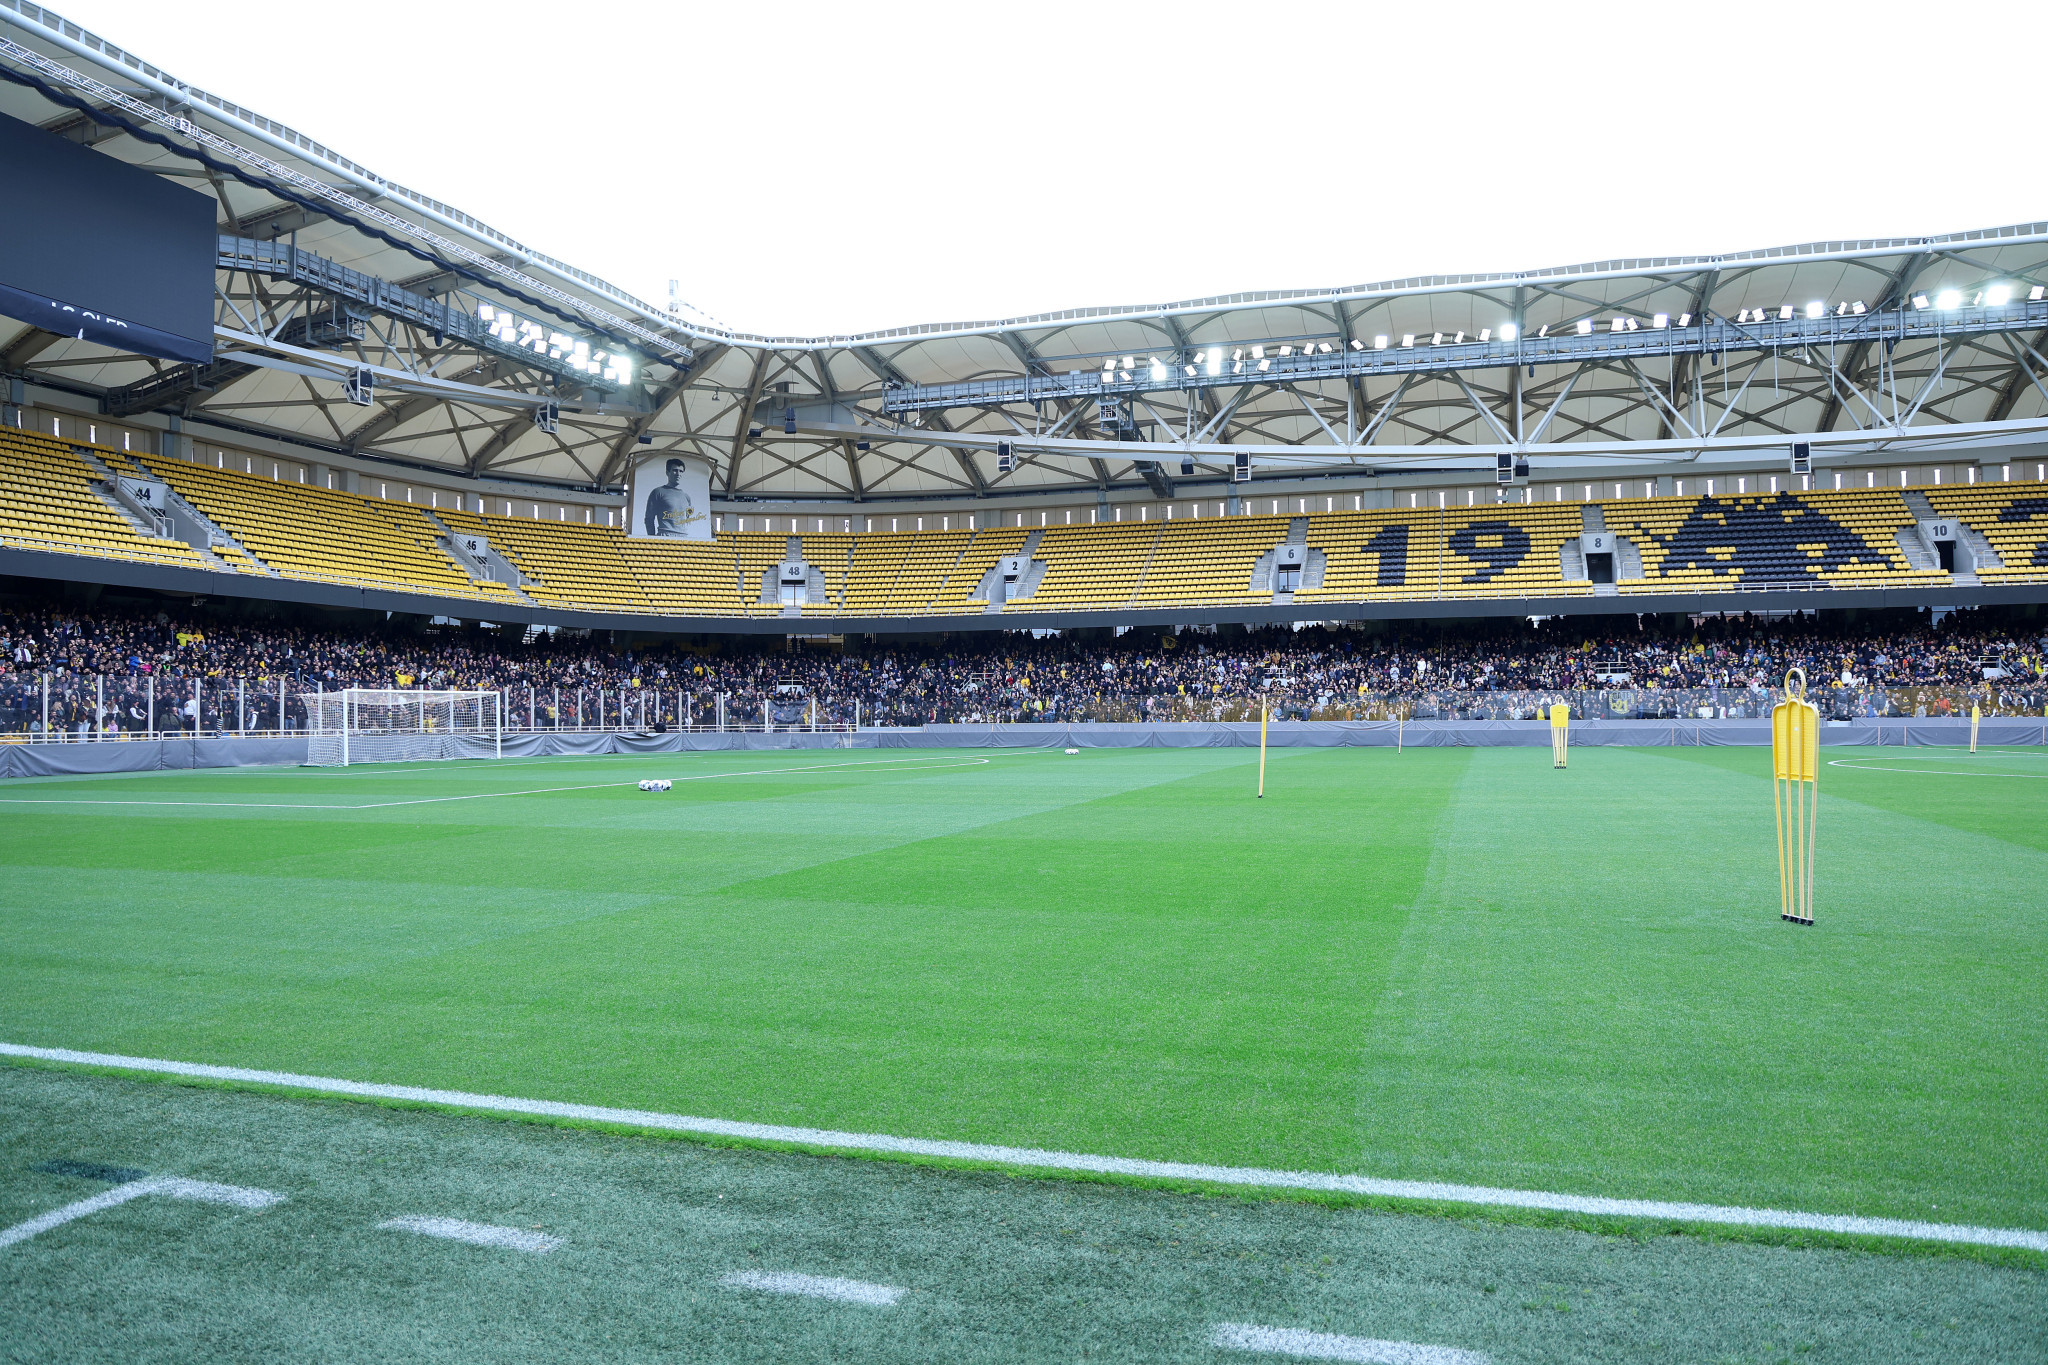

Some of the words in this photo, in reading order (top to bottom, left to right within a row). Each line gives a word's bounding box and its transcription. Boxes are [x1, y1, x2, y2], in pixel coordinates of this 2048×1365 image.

[135, 486, 151, 501] 44
[1932, 525, 1948, 537] 10
[466, 539, 477, 551] 46
[1594, 537, 1602, 548] 8
[1288, 548, 1295, 559] 6
[1361, 521, 1532, 586] 19
[788, 566, 800, 576] 48
[1012, 561, 1018, 571] 2
